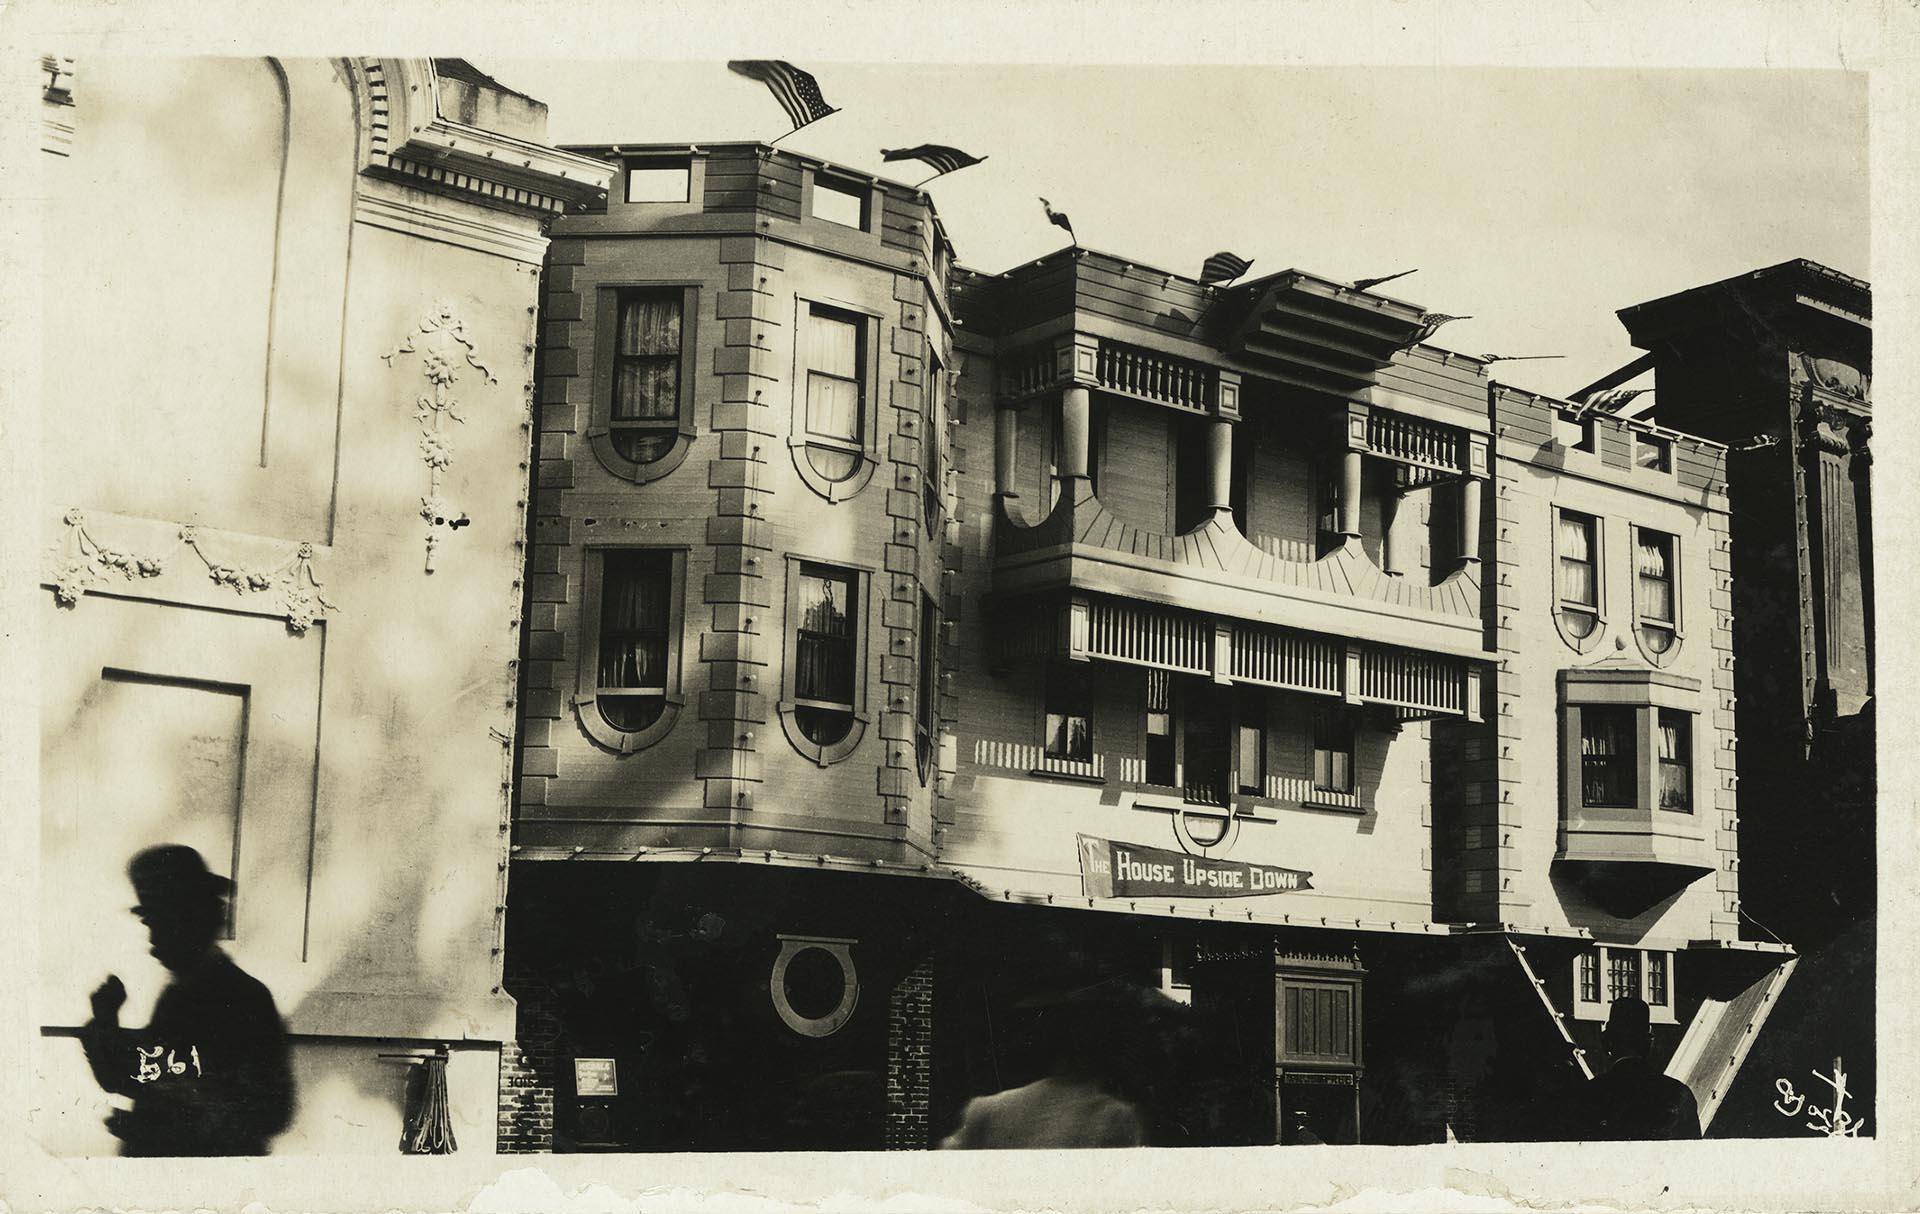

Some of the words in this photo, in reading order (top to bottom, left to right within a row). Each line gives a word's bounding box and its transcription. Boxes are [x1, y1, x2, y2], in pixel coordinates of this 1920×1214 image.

[1116, 850, 1175, 884] HOUSE
[1183, 858, 1243, 888] UPSIDE
[1250, 867, 1298, 890] DOWN
